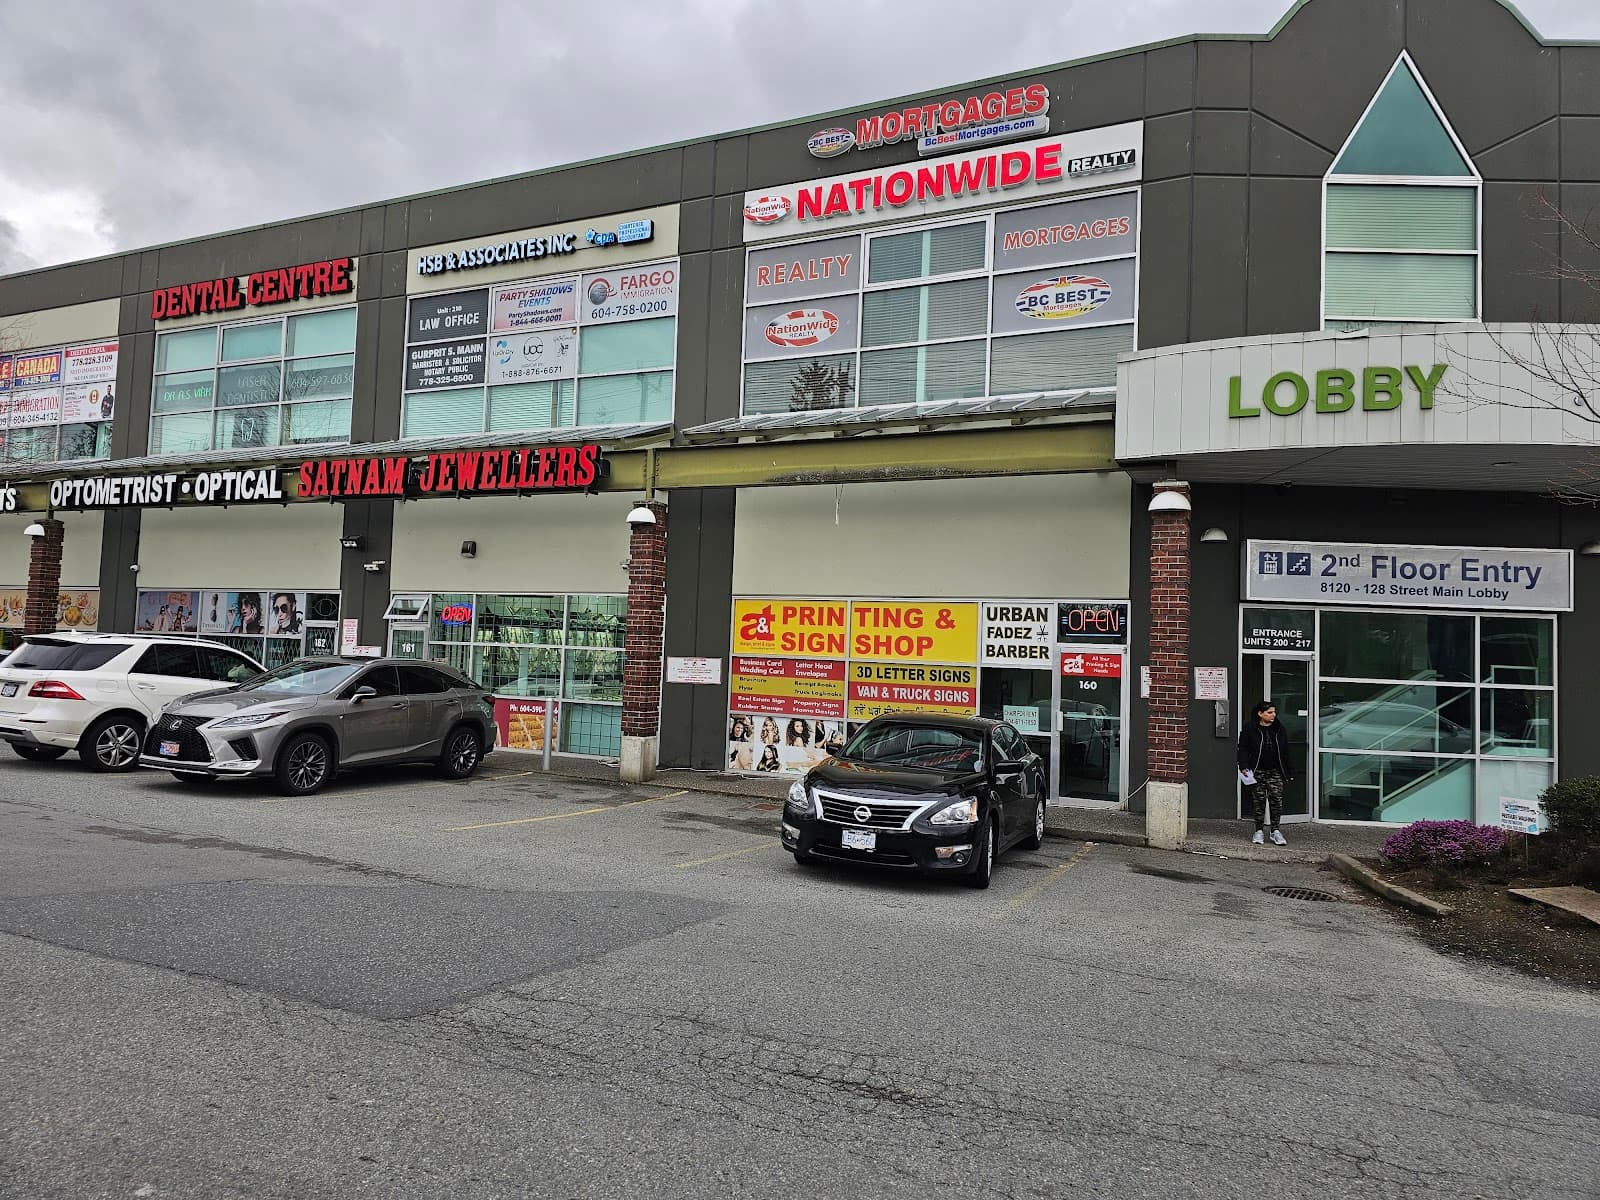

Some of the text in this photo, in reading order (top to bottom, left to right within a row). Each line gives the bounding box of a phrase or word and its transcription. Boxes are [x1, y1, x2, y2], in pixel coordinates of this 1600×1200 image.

[856, 84, 1049, 144] MORTGAGES
[813, 138, 824, 147] BC
[825, 134, 846, 144] BEST
[924, 118, 1035, 147] BcBestMortgages.com
[797, 143, 1133, 220] NATIONWIDE REALTY
[745, 202, 791, 214] NationWide
[1003, 216, 1131, 251] MORTGAGES
[417, 232, 576, 275] HSB & ASSOCIATES INC
[756, 254, 853, 287] REALTY
[152, 258, 350, 320] DENTAL CENTRE
[620, 270, 675, 291] FARGO
[500, 284, 573, 302] PARTY SHADOWS
[620, 286, 673, 301] IMMIGRATION
[1028, 288, 1098, 307] BC BEST
[518, 296, 551, 308] EVENTS
[591, 300, 668, 320] 604-758-0200
[1043, 302, 1082, 312] Mortgages
[419, 312, 480, 331] LAW OFFICE
[508, 307, 562, 319] PartyShadows.com
[767, 319, 838, 336] NationWide
[411, 347, 447, 360] GURPRIT
[457, 343, 484, 355] MANN
[17, 356, 57, 377] CANADA
[412, 354, 482, 370] BARRISTER & SOLICITOR
[424, 364, 469, 376] NOTARY PUBLIC
[238, 375, 268, 389] LASER
[1229, 363, 1449, 418] LOBBY
[298, 444, 598, 497] SATNAM JEWELLERS
[50, 470, 282, 506] OPTOMETRIST OPTICAL
[1320, 553, 1542, 590] 2nd Floor Entry
[1320, 582, 1351, 594] 8120
[1363, 583, 1386, 595] 128
[1389, 584, 1429, 597] Street
[1432, 585, 1464, 598] Main
[1468, 587, 1509, 601] Lobby
[441, 605, 472, 622] OPEN
[782, 606, 956, 630] PRIN TING &
[986, 607, 1049, 623] URBAN
[1068, 609, 1119, 632] OPEN
[986, 626, 1033, 640] FADEZ
[1252, 628, 1303, 639] ENTRANCE
[315, 638, 326, 648] 162
[402, 643, 415, 653] 161
[781, 632, 934, 657] SIGN SHOP
[1244, 637, 1271, 647] UNITS
[1272, 637, 1289, 647] 200
[1296, 638, 1311, 648] 217
[986, 644, 1050, 660] BARBER
[739, 666, 785, 675] Wedding Card
[766, 659, 783, 667] Card
[814, 662, 833, 670] Head
[795, 669, 828, 678] Envelopes
[857, 666, 971, 683] 3D LETTER SIGNS
[1079, 680, 1098, 690] 160
[857, 685, 970, 703] VAN & TRUCK SIGNS
[509, 704, 519, 712] Ph:
[761, 704, 784, 712] Stamps
[793, 699, 821, 708] Property
[815, 708, 840, 716] Design
